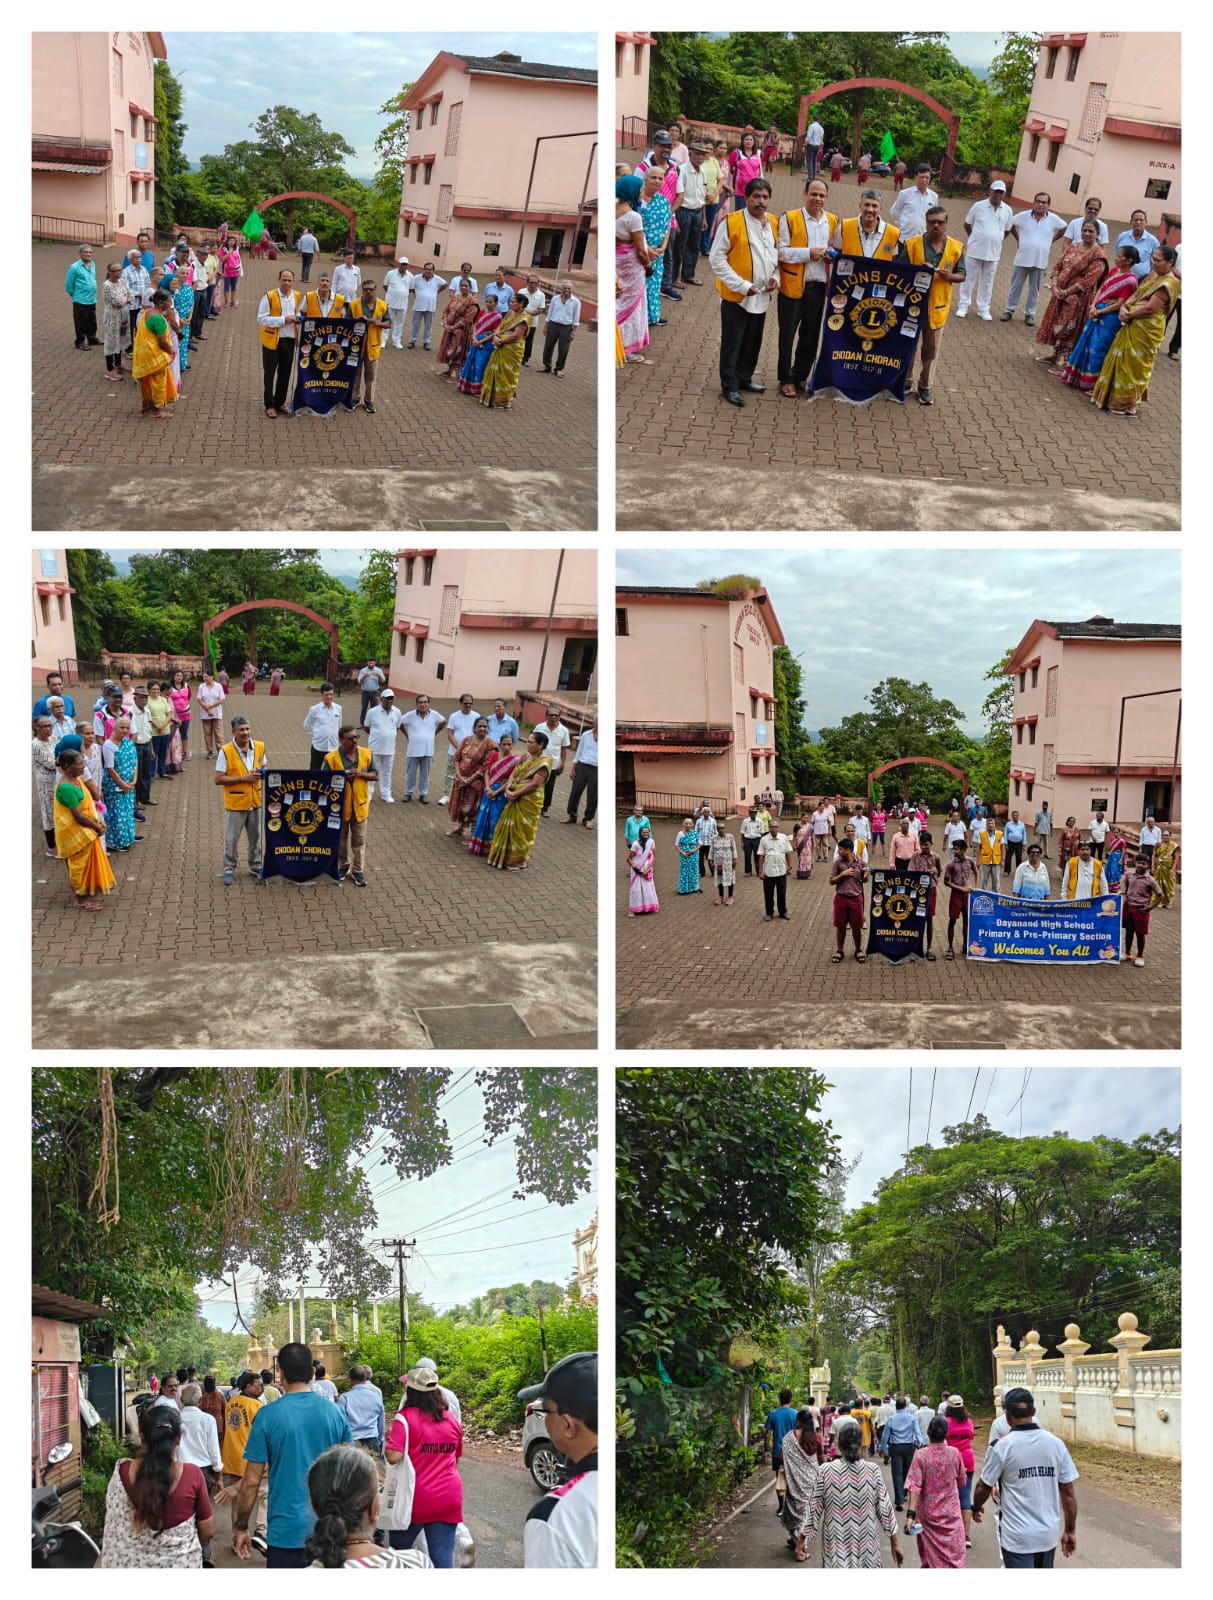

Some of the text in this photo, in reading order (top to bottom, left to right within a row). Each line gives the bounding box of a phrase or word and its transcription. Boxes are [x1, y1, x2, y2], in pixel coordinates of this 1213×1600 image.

[1149, 160, 1176, 170] BLOCK-A
[836, 270, 922, 304] LIONS CLUB
[868, 311, 880, 325] L
[305, 325, 361, 344] LIONS CLUB
[326, 352, 333, 361] L
[832, 350, 863, 361] CHODAN
[270, 779, 341, 802] LIONS CLUB
[301, 812, 310, 823] L
[876, 878, 925, 894] LIONS CLUB
[897, 902, 903, 911] L
[996, 919, 1095, 930] Dayanand High School
[978, 929, 1112, 941] Primary & Pre-Primary Section
[994, 944, 1090, 955] Welcomes You All
[1018, 1466, 1038, 1479] JOYFUL
